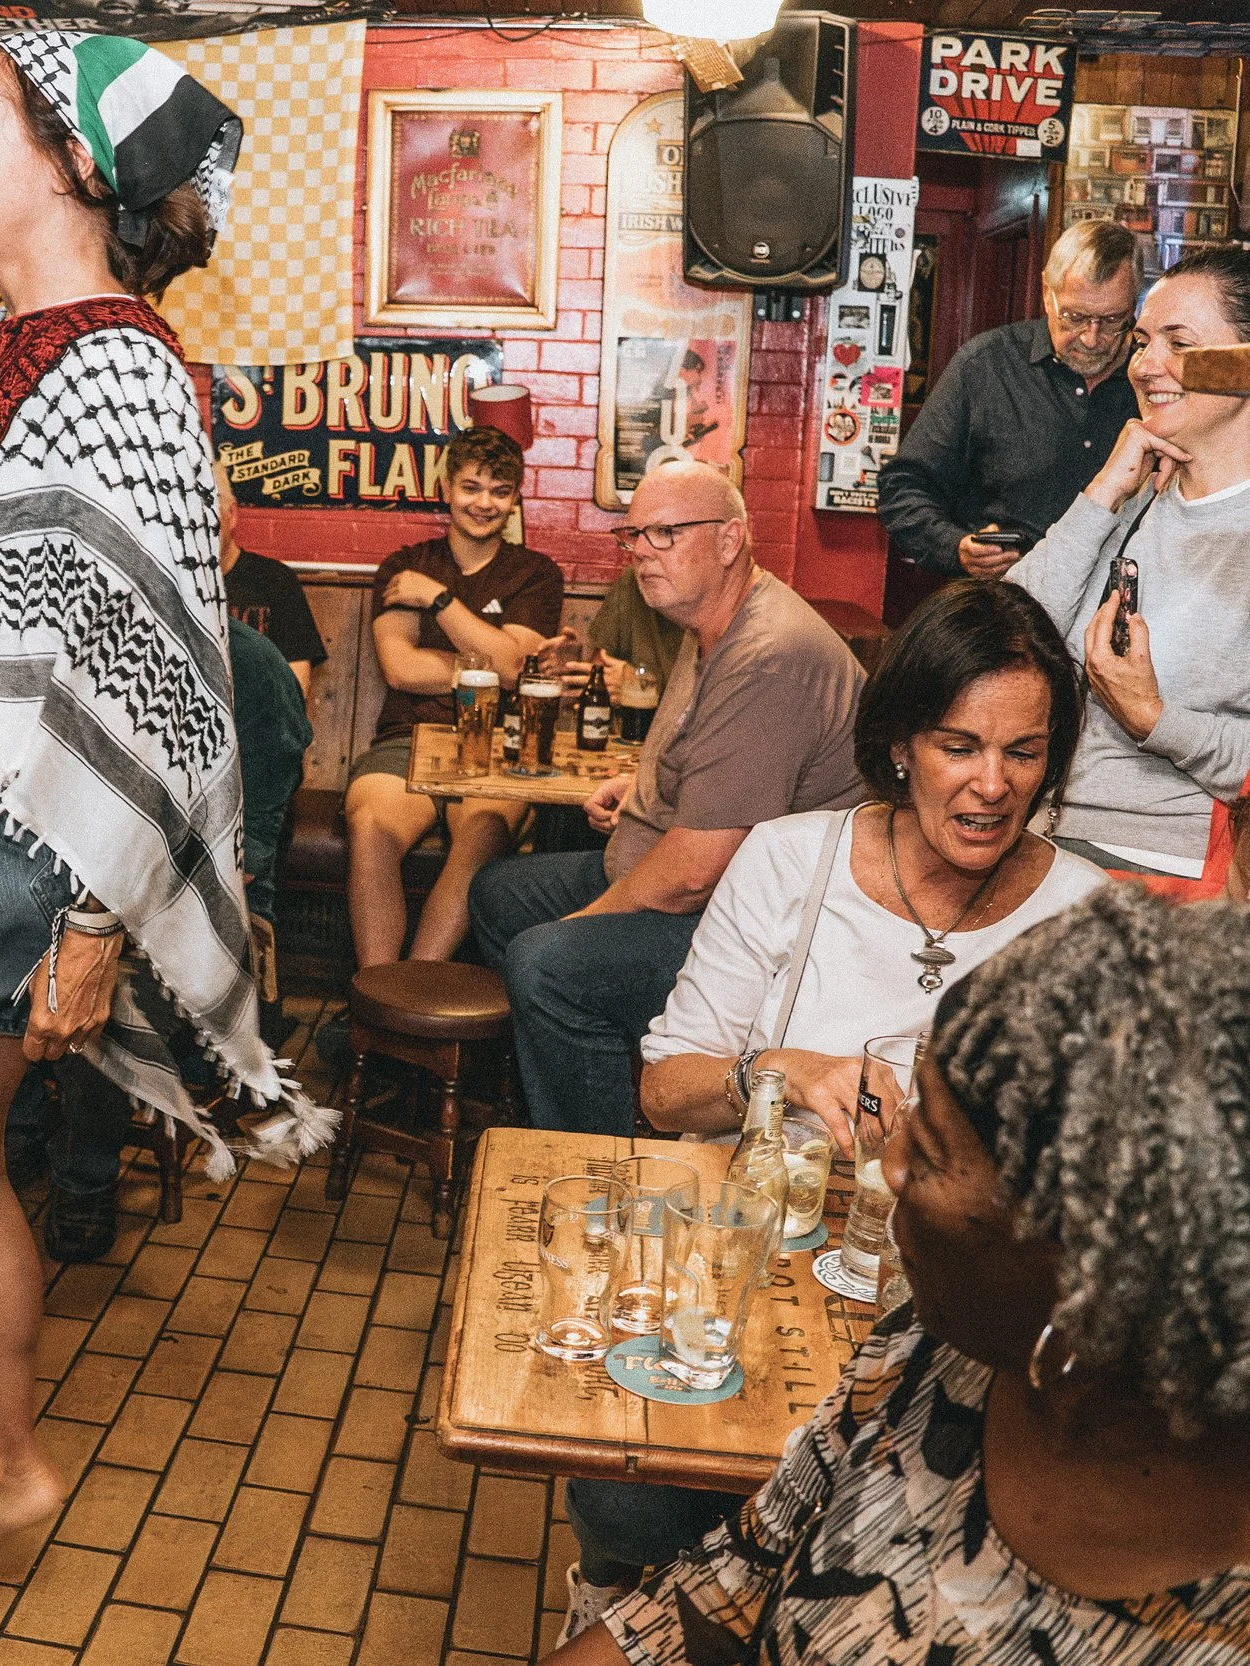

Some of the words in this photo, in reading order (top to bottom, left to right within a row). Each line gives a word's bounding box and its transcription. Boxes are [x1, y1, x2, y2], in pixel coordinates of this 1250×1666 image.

[931, 36, 1067, 75] PARK
[929, 68, 1062, 107] DRIVE
[226, 446, 255, 463] THE
[237, 452, 306, 479] STANDARD
[326, 440, 450, 503] FLAK
[272, 470, 311, 491] DARK
[776, 1325, 817, 1415] STILL
